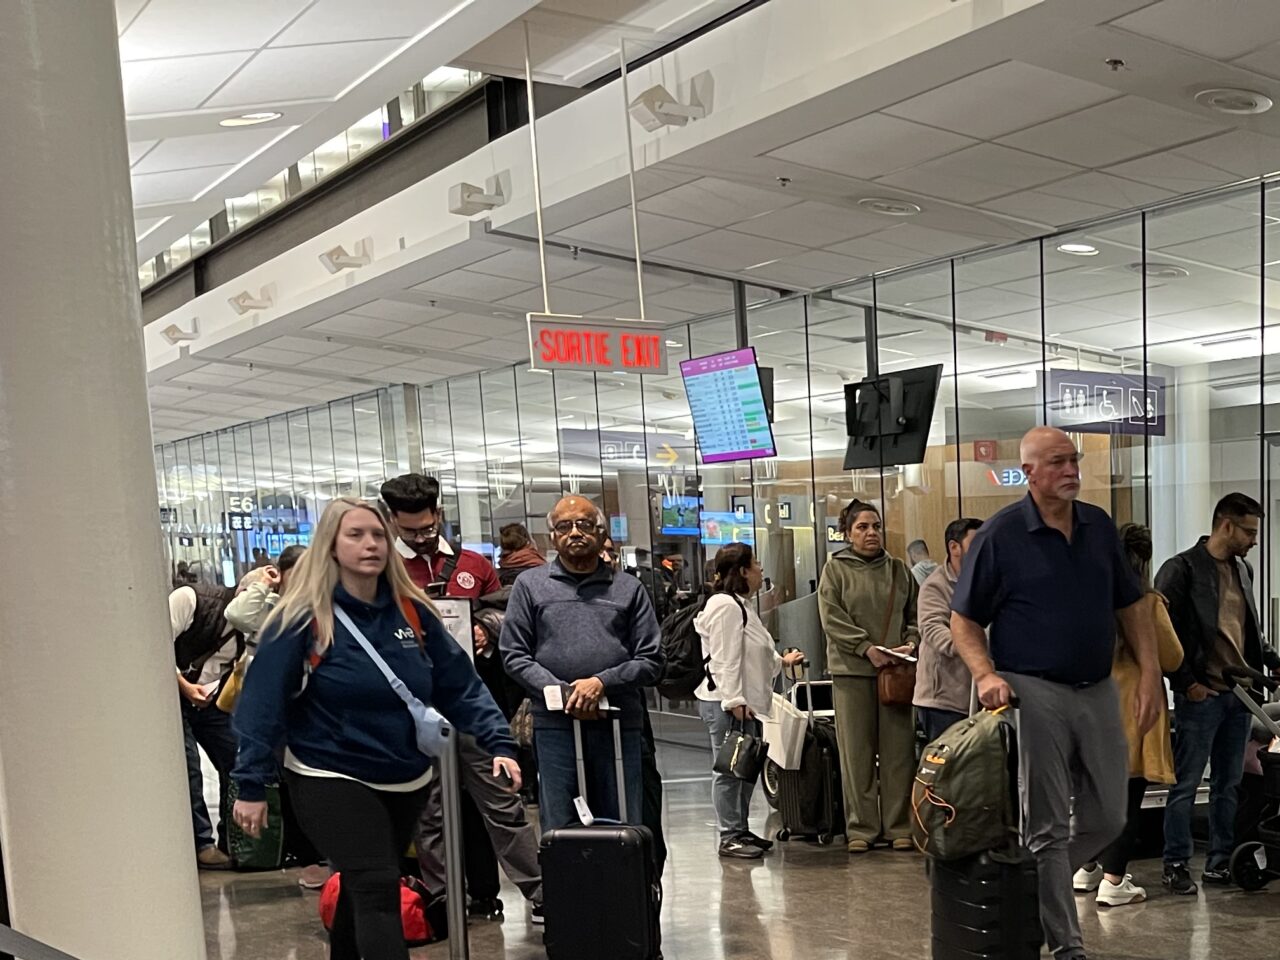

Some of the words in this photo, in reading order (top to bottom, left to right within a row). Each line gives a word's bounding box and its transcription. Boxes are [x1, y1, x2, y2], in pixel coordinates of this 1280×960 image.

[540, 329, 613, 366] SORTIE
[620, 333, 661, 369] EXIT
[229, 496, 254, 513] 56
